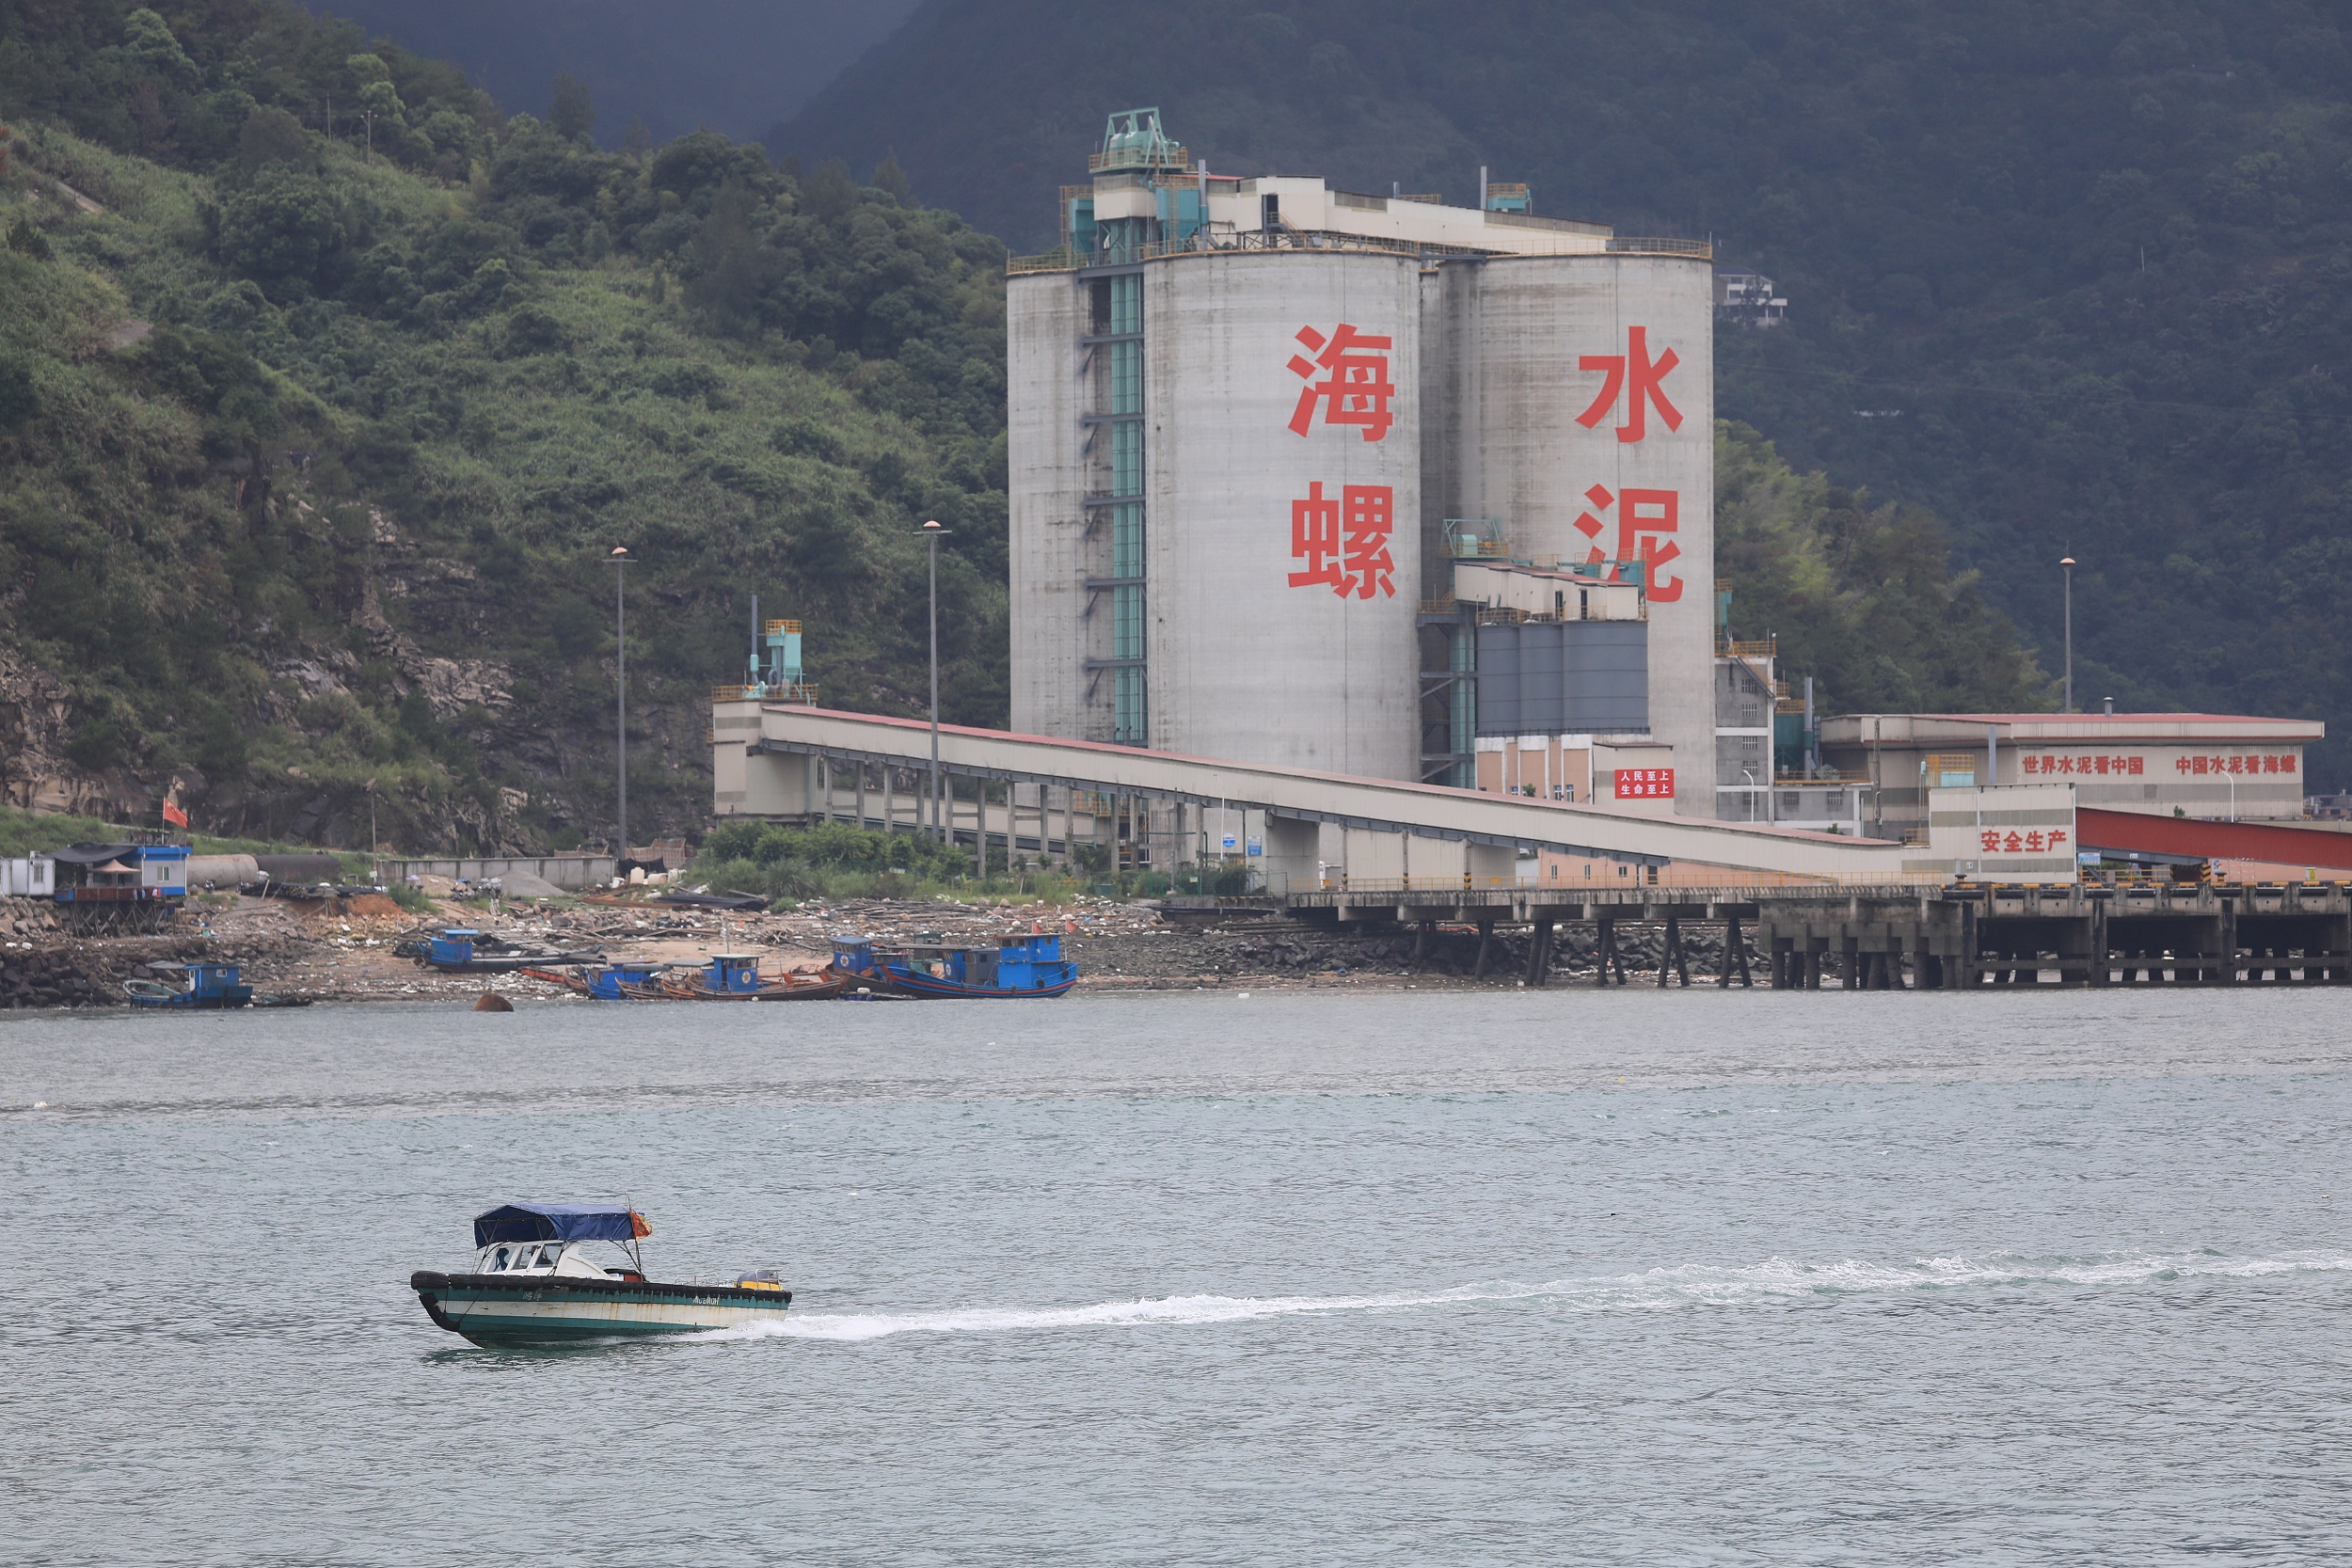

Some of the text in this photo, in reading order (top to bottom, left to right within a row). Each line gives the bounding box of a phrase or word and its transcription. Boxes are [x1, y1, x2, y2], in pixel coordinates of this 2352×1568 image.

[1286, 323, 1395, 599] 海螺
[1574, 325, 1684, 602] 水泥
[2023, 755, 2144, 775] 世界水泥看中国
[2176, 755, 2296, 775] 中国水泥看海螺
[1621, 770, 1669, 782] 人民至上
[1621, 784, 1670, 795] 生命至上
[1981, 830, 2067, 852] 安全生产
